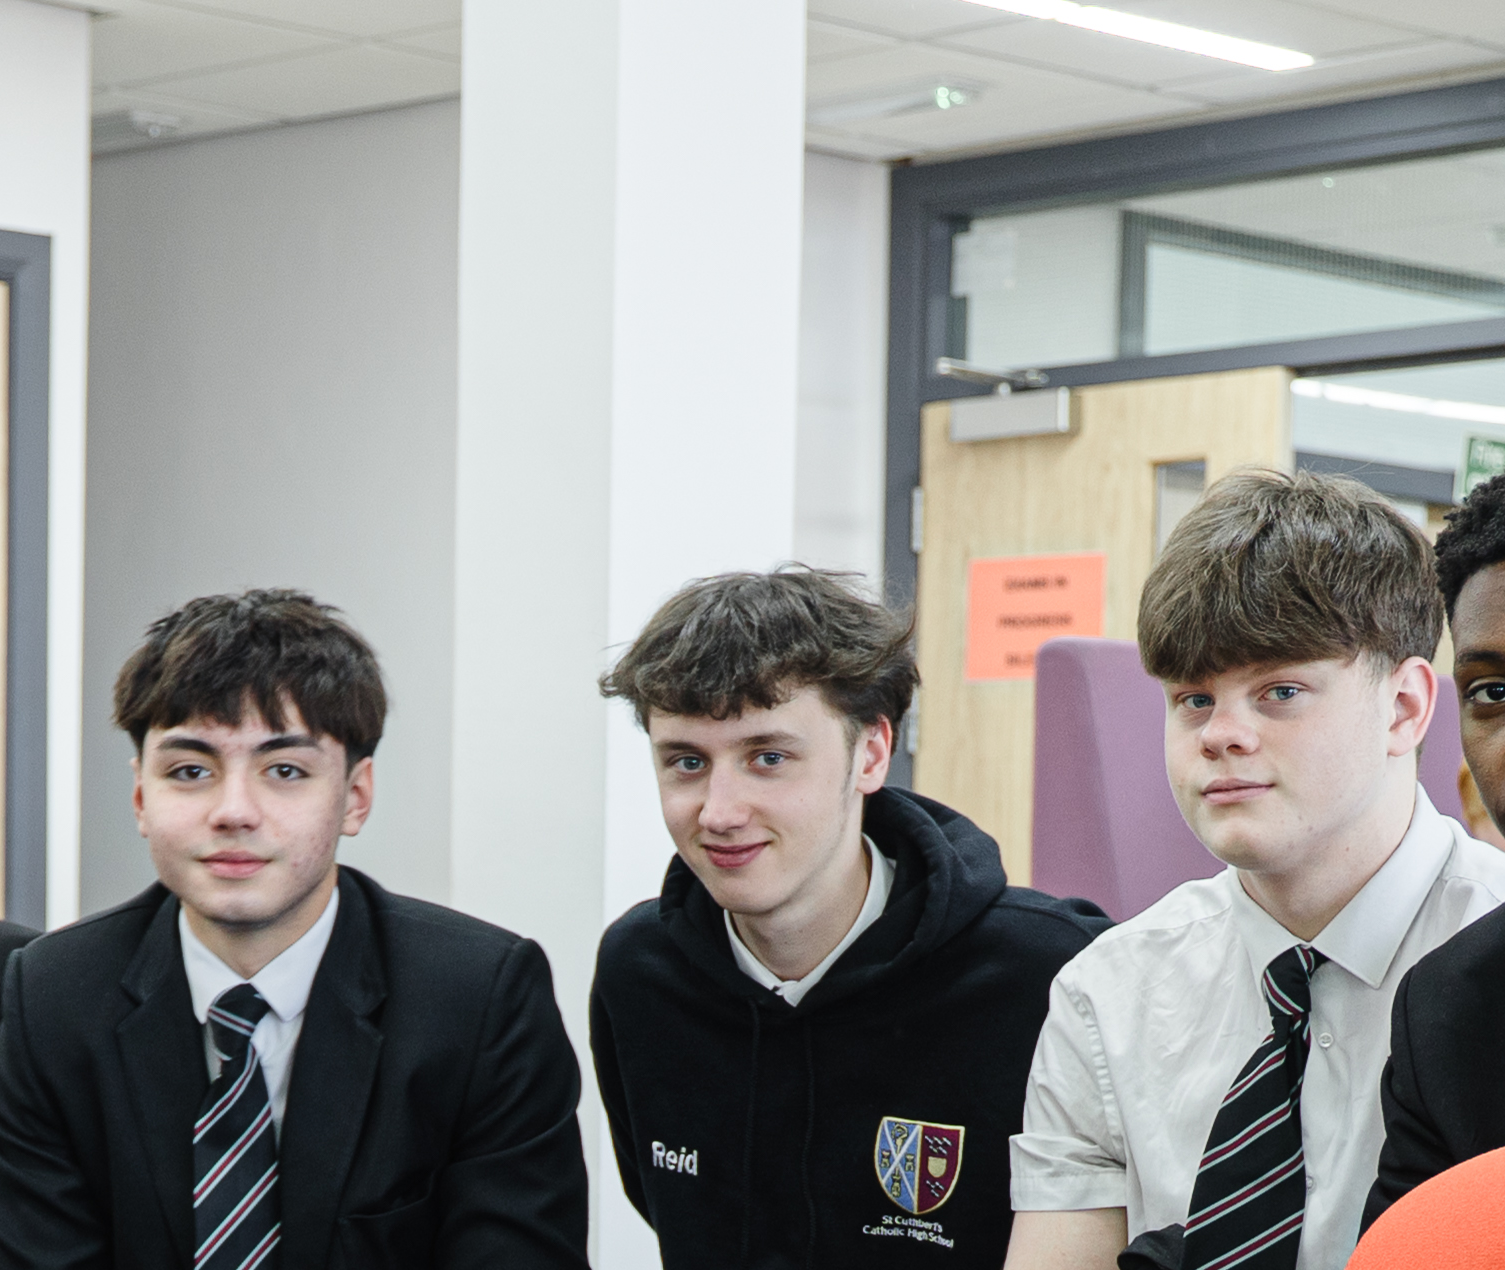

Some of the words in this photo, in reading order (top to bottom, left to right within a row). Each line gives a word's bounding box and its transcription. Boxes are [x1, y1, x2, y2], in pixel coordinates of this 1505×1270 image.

[652, 1141, 698, 1176] Reid
[882, 1215, 893, 1225] St
[862, 1224, 905, 1236] Catholic
[907, 1227, 928, 1241] High
